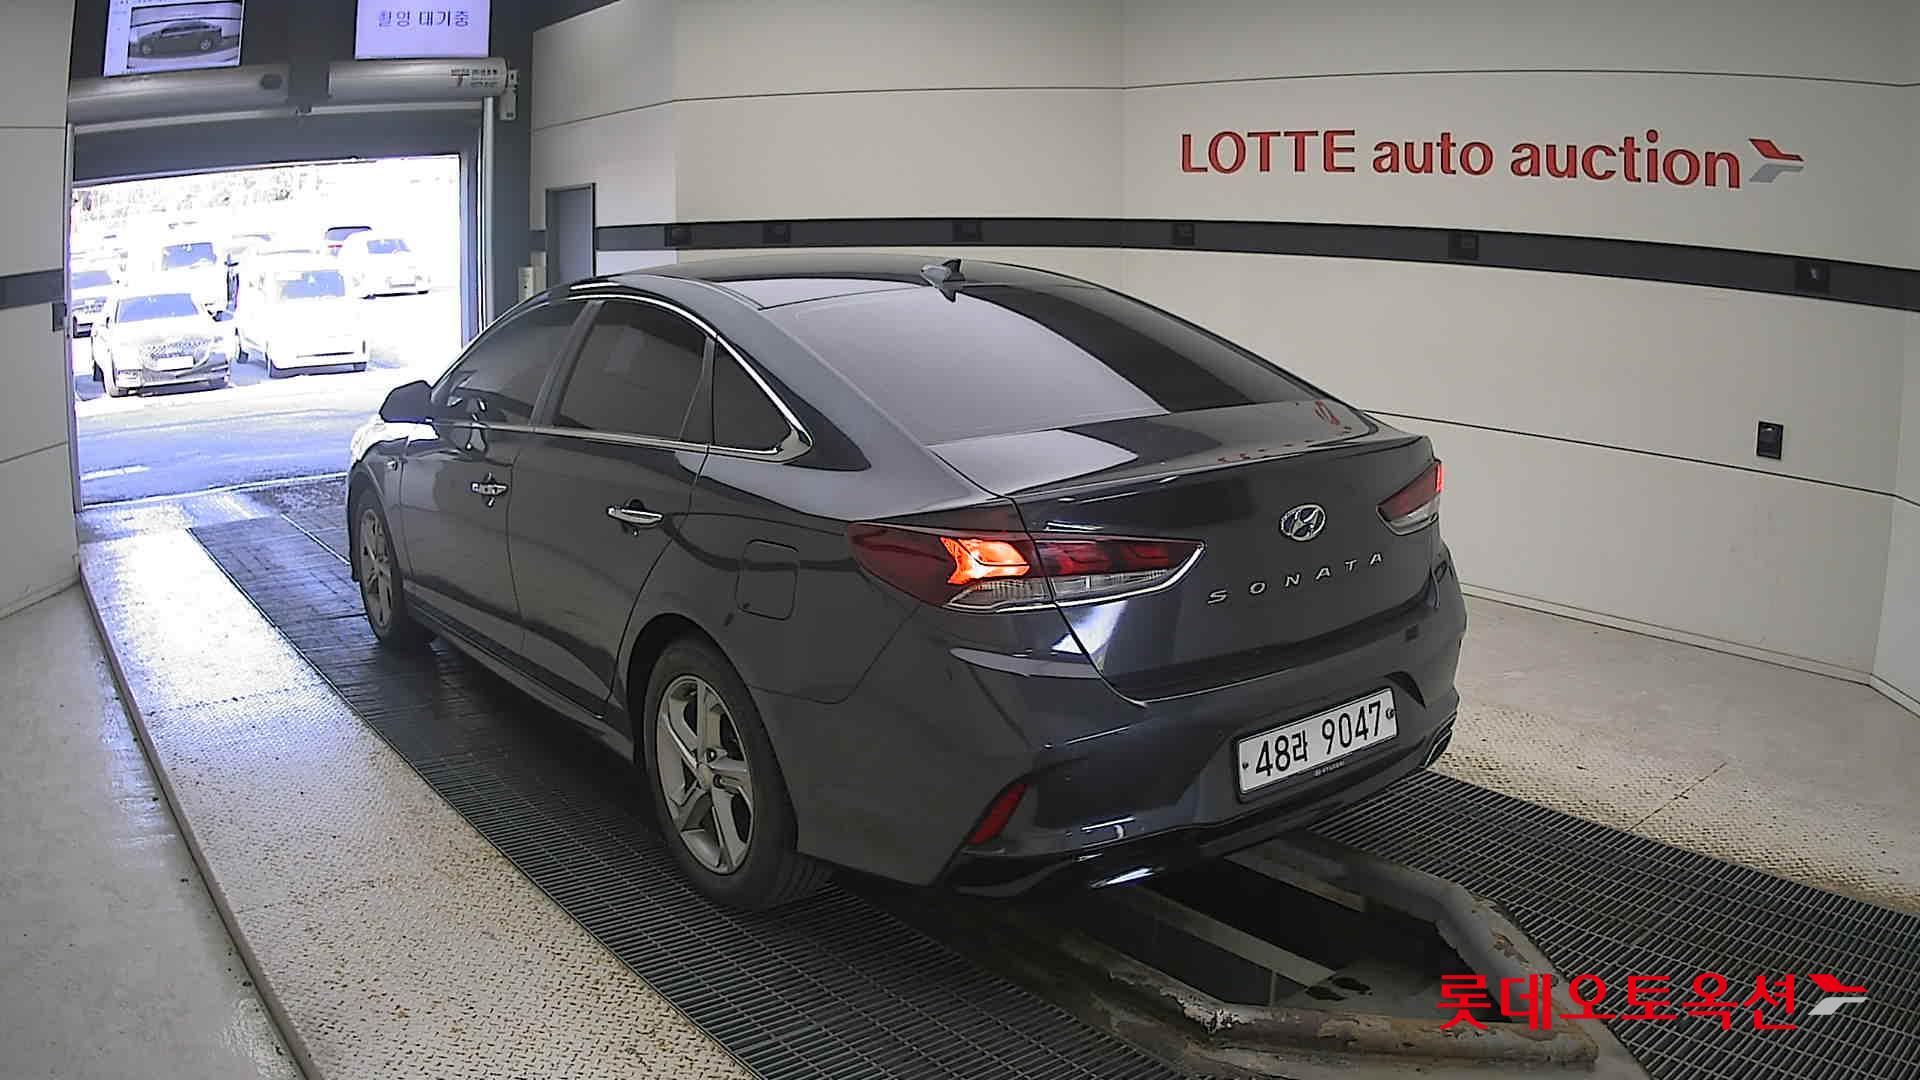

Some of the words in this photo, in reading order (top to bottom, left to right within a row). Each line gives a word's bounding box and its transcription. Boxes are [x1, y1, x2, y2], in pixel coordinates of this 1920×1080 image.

[1181, 130, 1356, 174] LOTTE
[1372, 131, 1495, 176] auto
[1510, 130, 1742, 189] auction
[1207, 551, 1384, 605] SONATA
[1255, 729, 1309, 777] 48라
[1321, 700, 1382, 755] 9047
